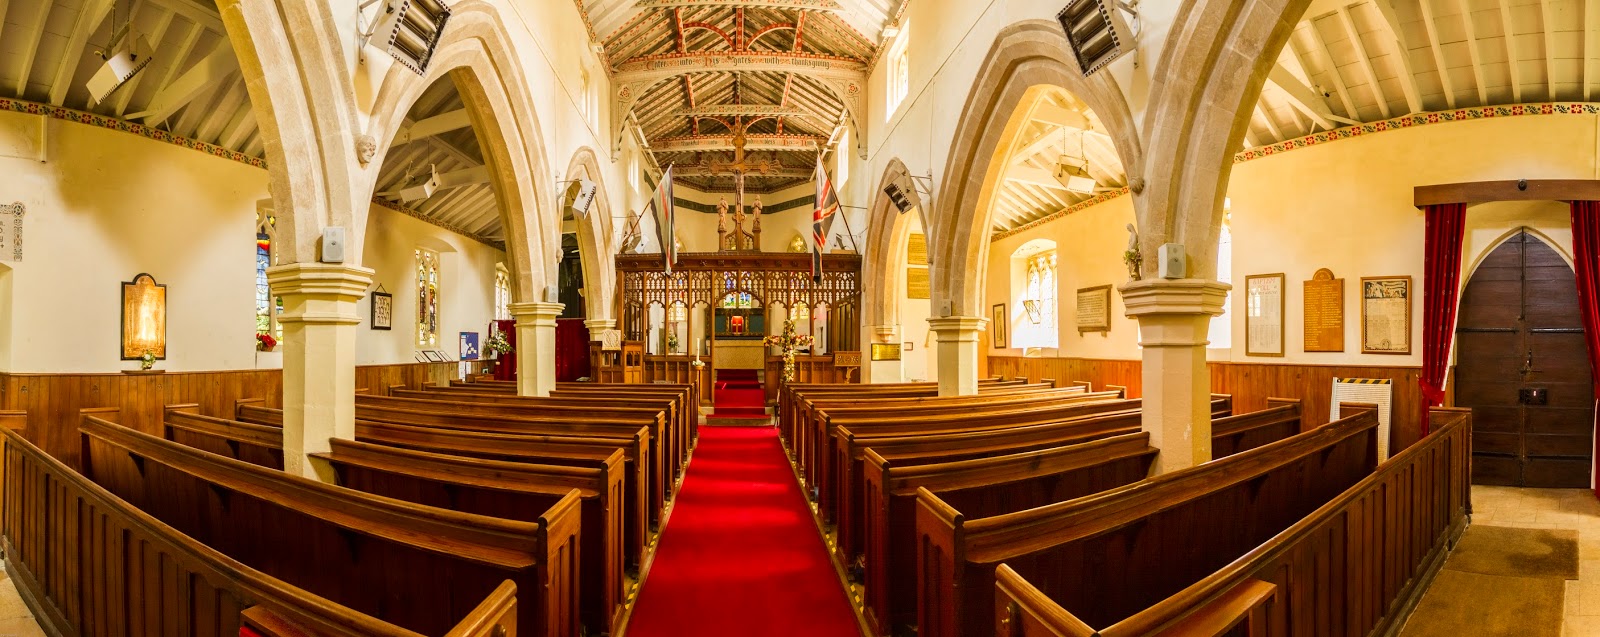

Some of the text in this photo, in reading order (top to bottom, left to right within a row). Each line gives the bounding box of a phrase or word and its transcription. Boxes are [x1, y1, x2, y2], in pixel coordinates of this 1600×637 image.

[680, 58, 692, 66] into
[733, 57, 751, 66] gates
[765, 56, 779, 64] with
[791, 57, 830, 69] thanksgiving
